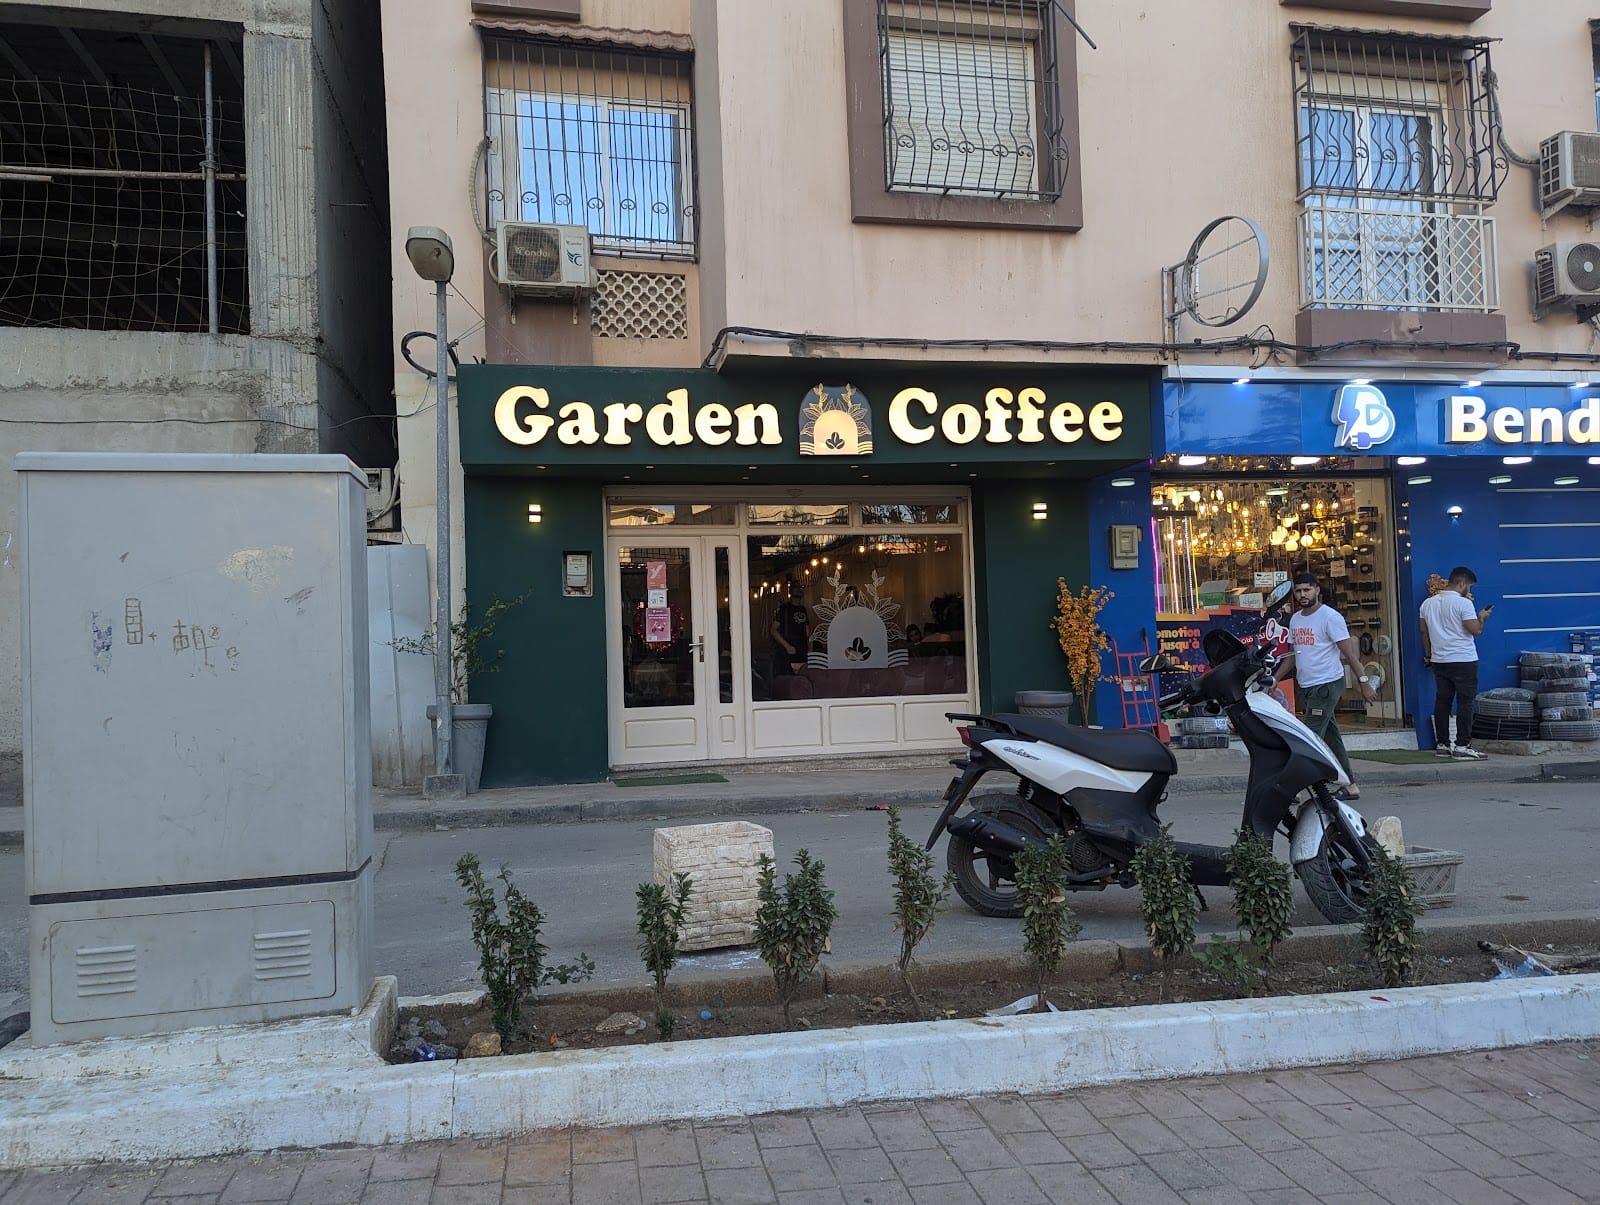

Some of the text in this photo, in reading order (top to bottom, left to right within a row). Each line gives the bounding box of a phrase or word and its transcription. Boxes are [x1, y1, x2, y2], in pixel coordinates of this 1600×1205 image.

[494, 385, 1124, 446] Garden Coffee
[1446, 395, 1600, 444] Bend
